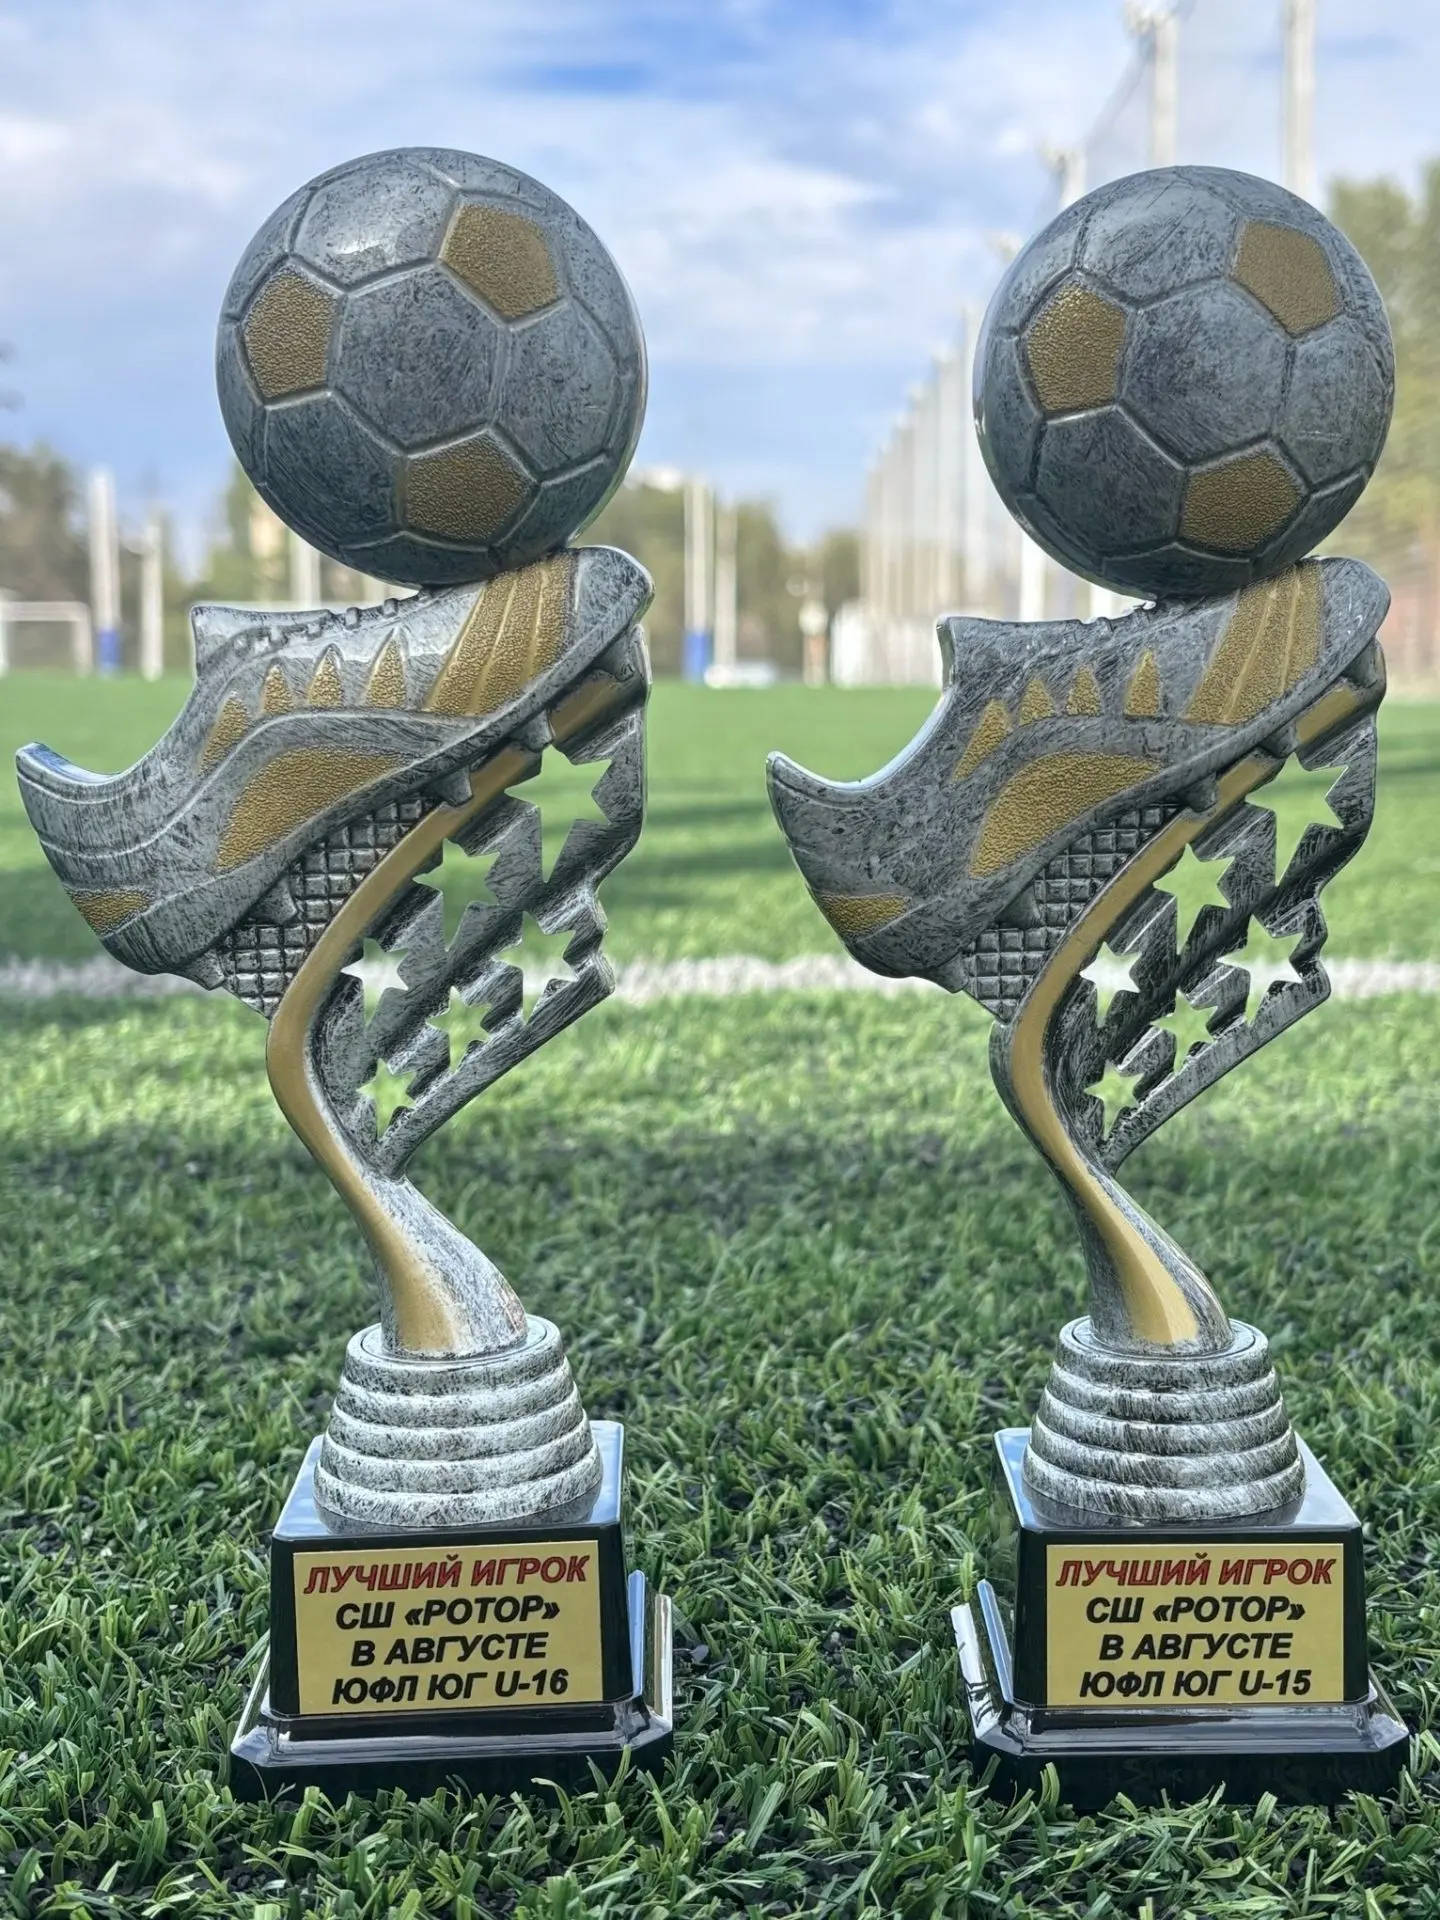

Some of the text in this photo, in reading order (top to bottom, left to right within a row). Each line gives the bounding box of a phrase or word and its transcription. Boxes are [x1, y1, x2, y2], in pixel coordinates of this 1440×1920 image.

[303, 1554, 590, 1594] ЛУЧШИЙ ИГРОК
[1055, 1552, 1337, 1587] ЛУЧШИЙ ИГРОК
[335, 1595, 560, 1629] СШ «РОТОР»
[1086, 1595, 1306, 1623] СШ «РОТОР»
[350, 1632, 549, 1666] В АВГУСТЕ
[1099, 1632, 1294, 1660] В АВГУСТЕ
[331, 1668, 569, 1705] ЮФЛ ЮГ U-16
[1079, 1669, 1312, 1698] ЮФЛ ЮГ U-15
